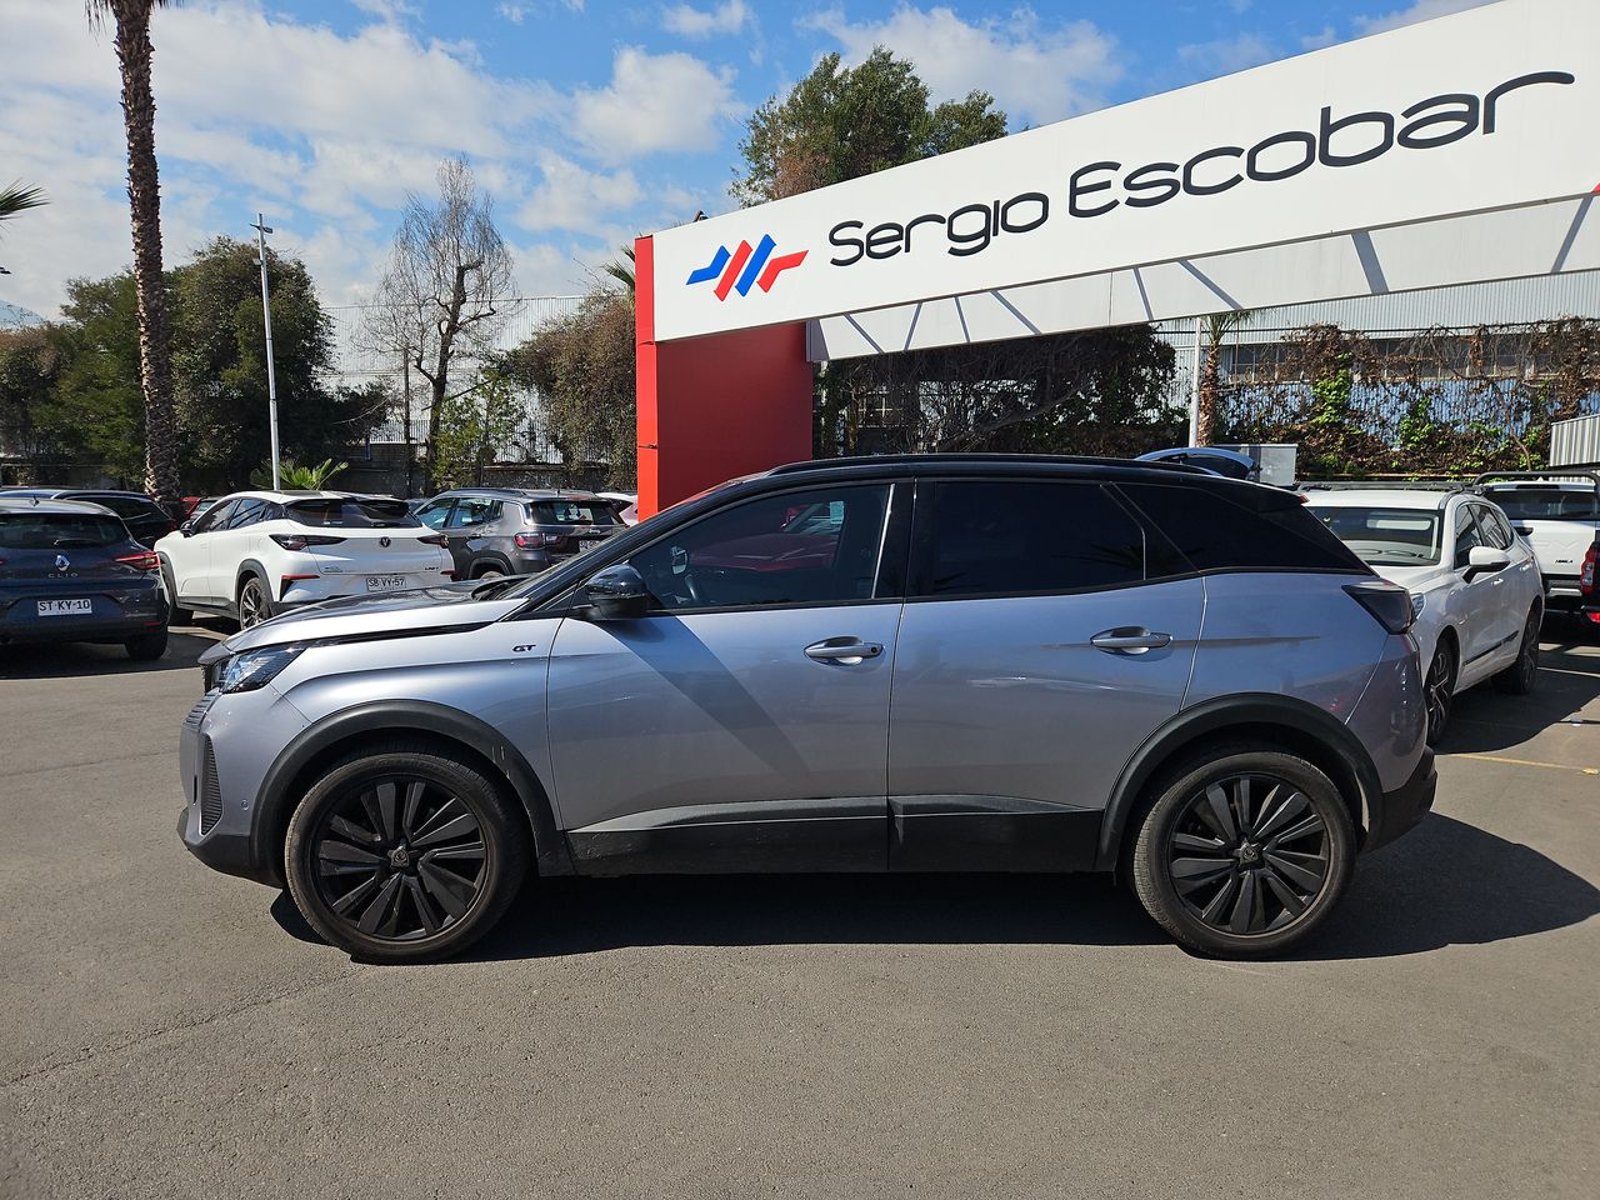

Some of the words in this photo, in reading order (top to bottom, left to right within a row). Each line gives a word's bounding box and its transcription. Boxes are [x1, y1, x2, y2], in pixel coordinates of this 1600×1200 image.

[828, 192, 1050, 267] Sergio
[1068, 71, 1575, 218] Escobar
[511, 644, 537, 653] GT
